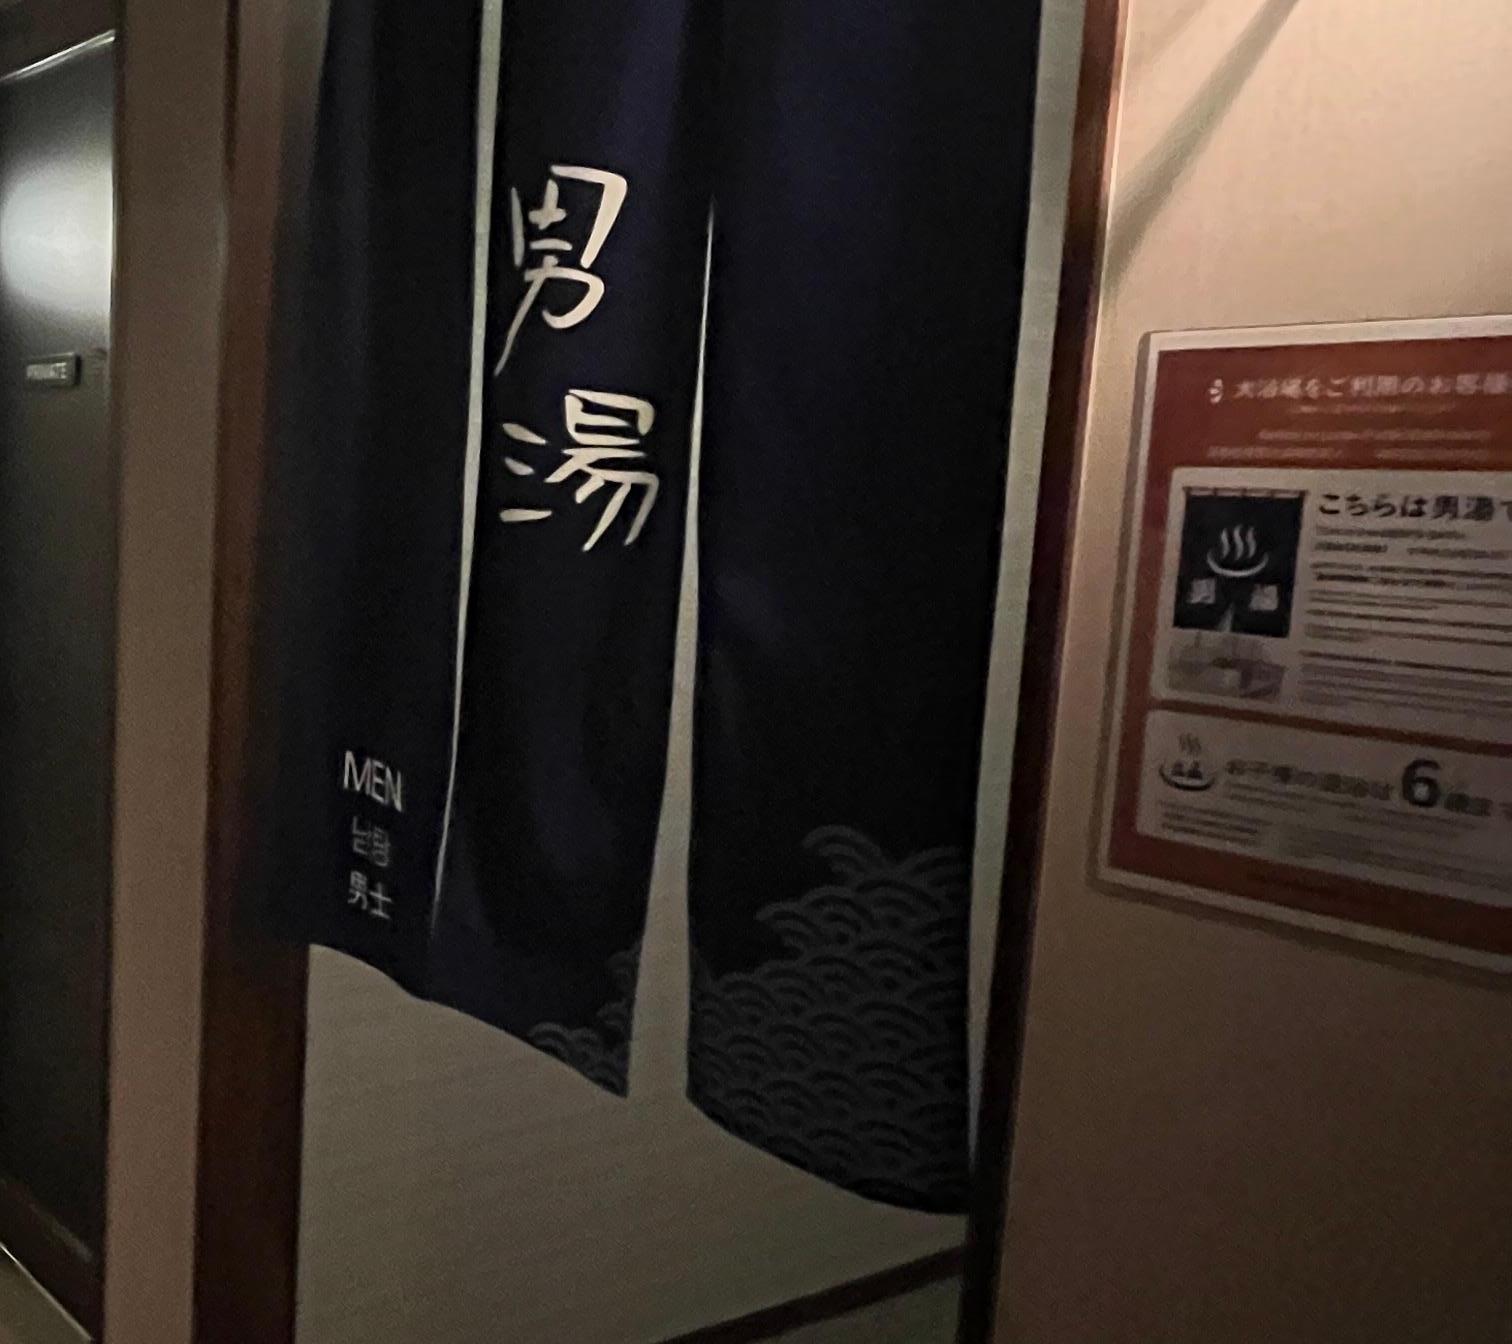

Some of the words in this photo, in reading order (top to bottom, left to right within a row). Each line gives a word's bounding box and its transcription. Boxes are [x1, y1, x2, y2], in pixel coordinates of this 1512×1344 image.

[494, 164, 659, 552] 男湯
[343, 749, 403, 813] MEN
[1402, 759, 1441, 808] 6
[347, 869, 393, 920] 男士
